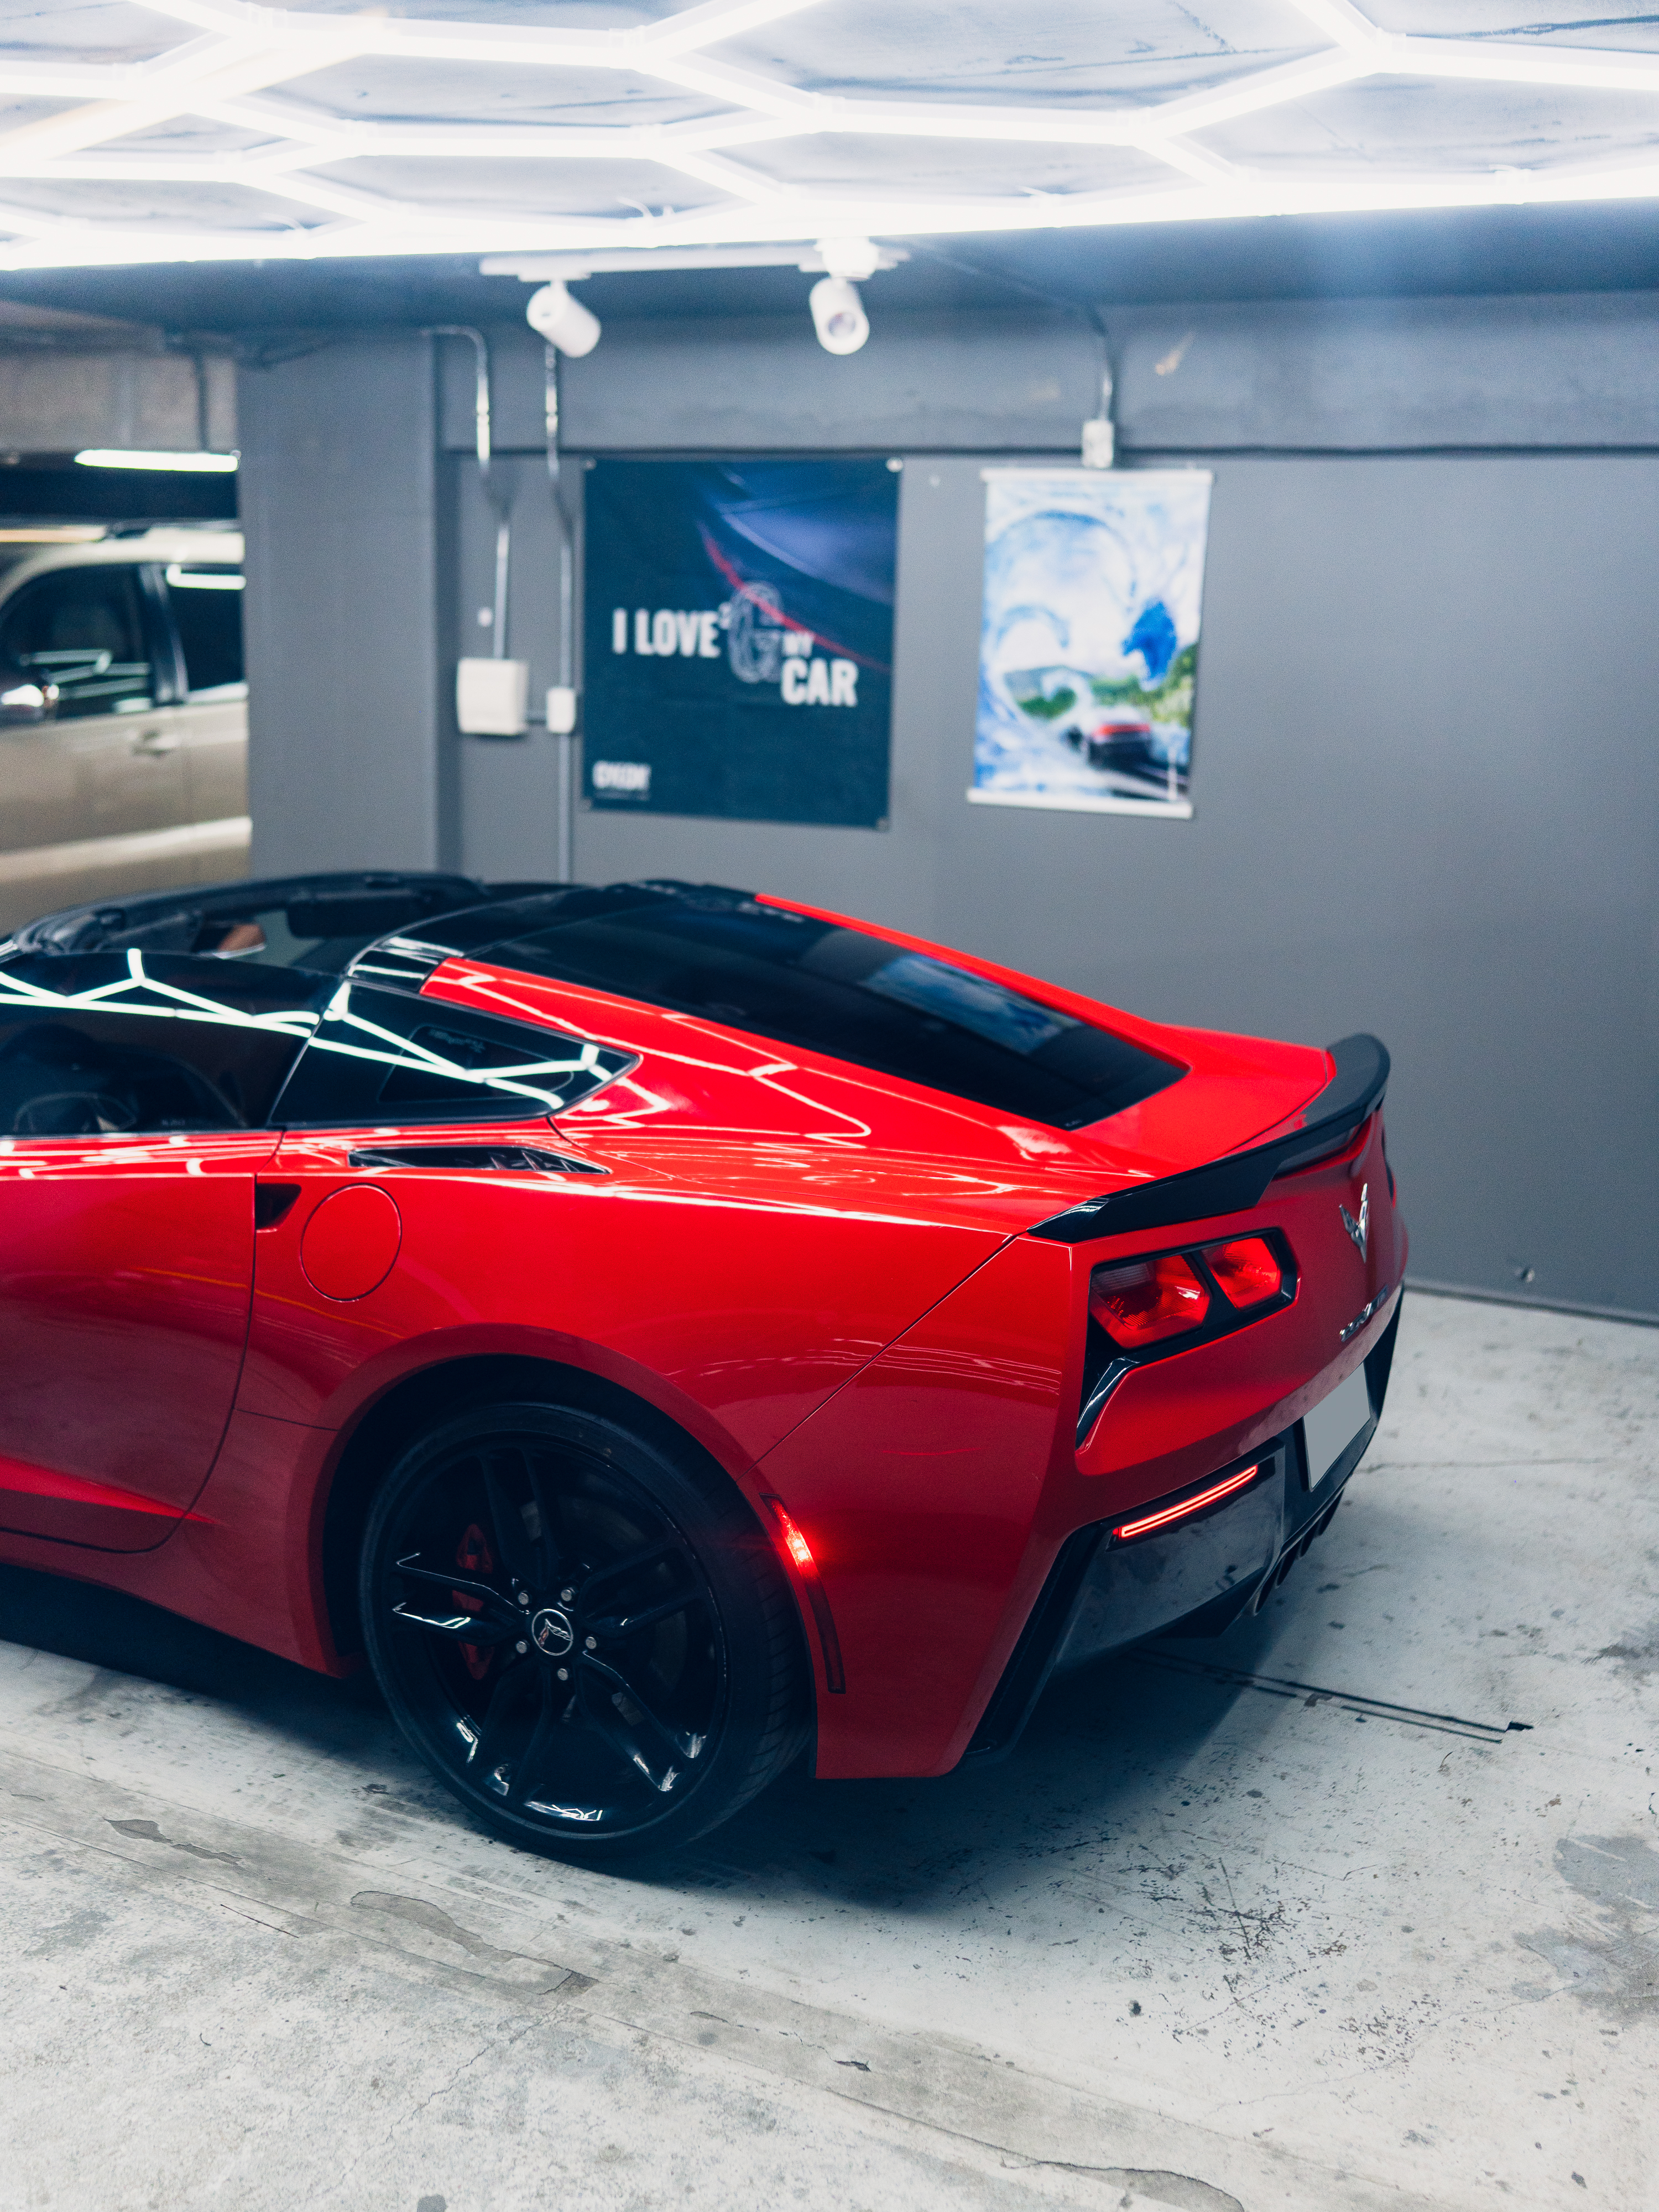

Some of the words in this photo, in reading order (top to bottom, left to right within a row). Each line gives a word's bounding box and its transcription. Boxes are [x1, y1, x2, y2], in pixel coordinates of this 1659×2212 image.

[612, 608, 627, 654] I
[635, 609, 721, 658] LOVE
[781, 658, 858, 706] CAR
